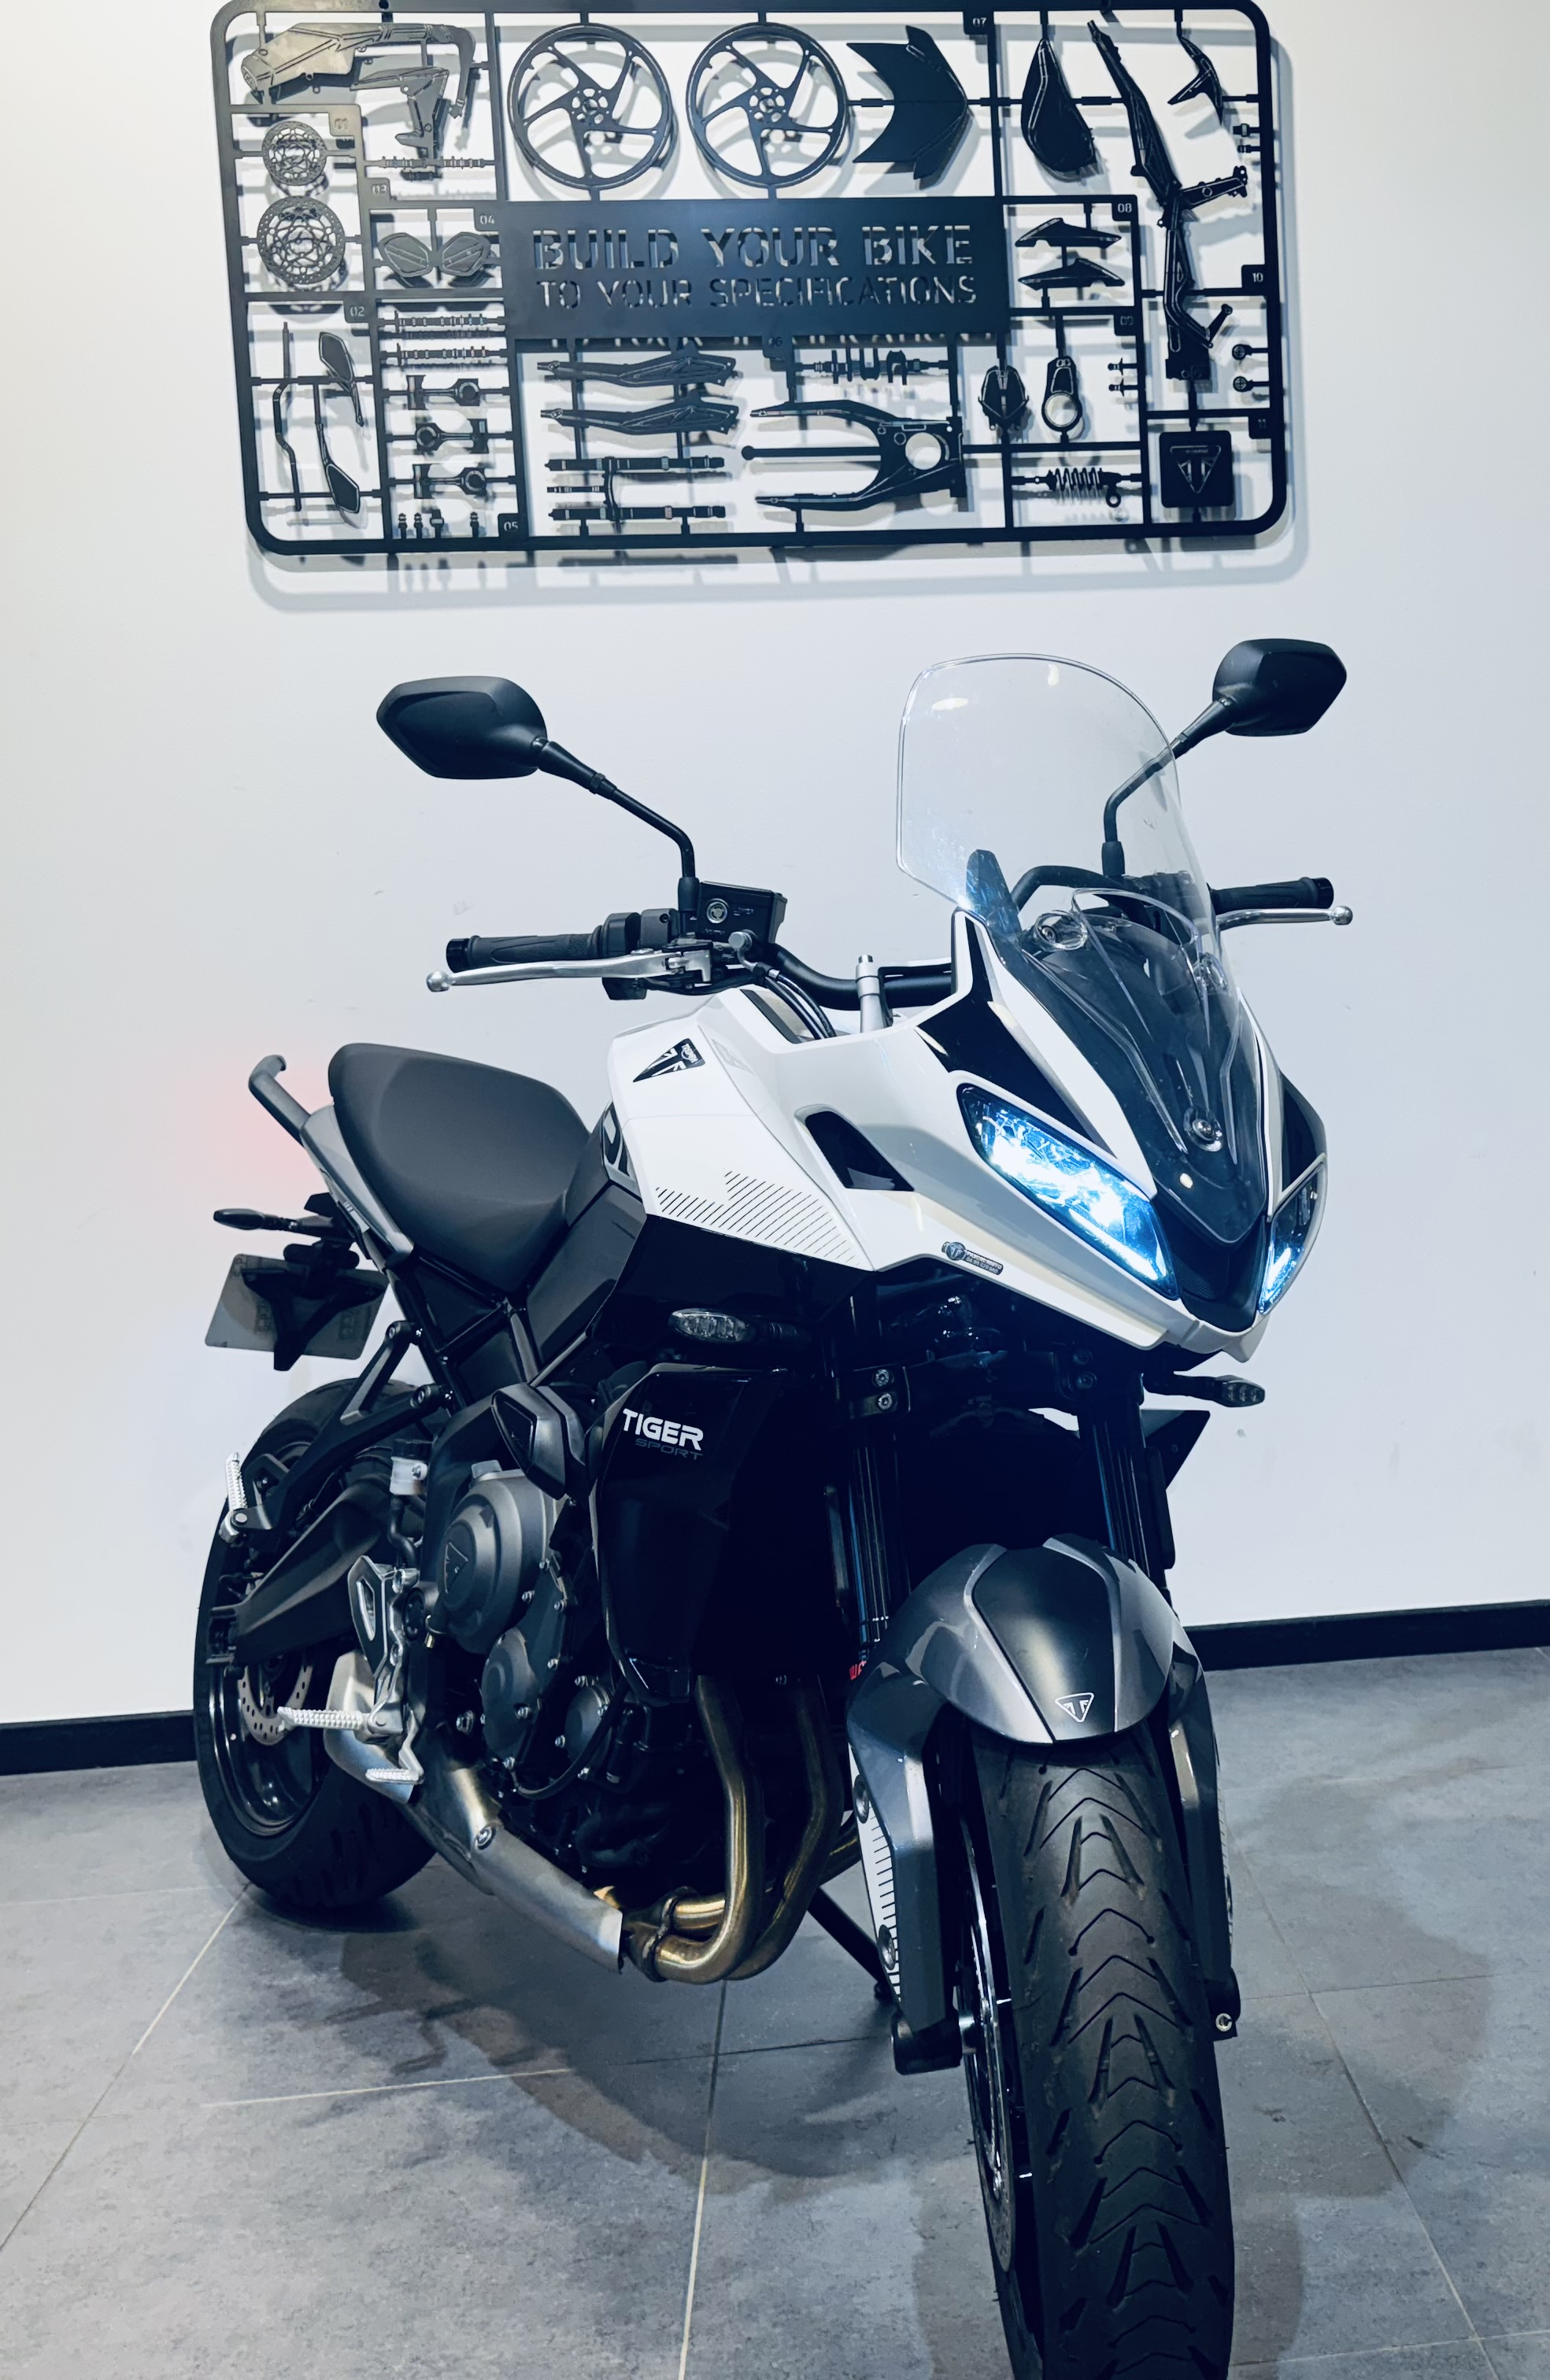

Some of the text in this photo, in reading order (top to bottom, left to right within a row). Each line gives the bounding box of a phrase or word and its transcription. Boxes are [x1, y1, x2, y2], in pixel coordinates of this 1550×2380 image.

[372, 183, 387, 195] 03
[1117, 202, 1133, 213] 08
[479, 214, 495, 225] 04
[532, 224, 973, 270] BUILD YOUR BIKE
[1252, 272, 1264, 283] 10
[536, 275, 978, 309] TO YOUR SPECIFICATIONS
[350, 305, 365, 317] 02
[503, 520, 519, 532] 05
[623, 1408, 704, 1451] TIGER
[634, 1438, 703, 1461] SPORT
